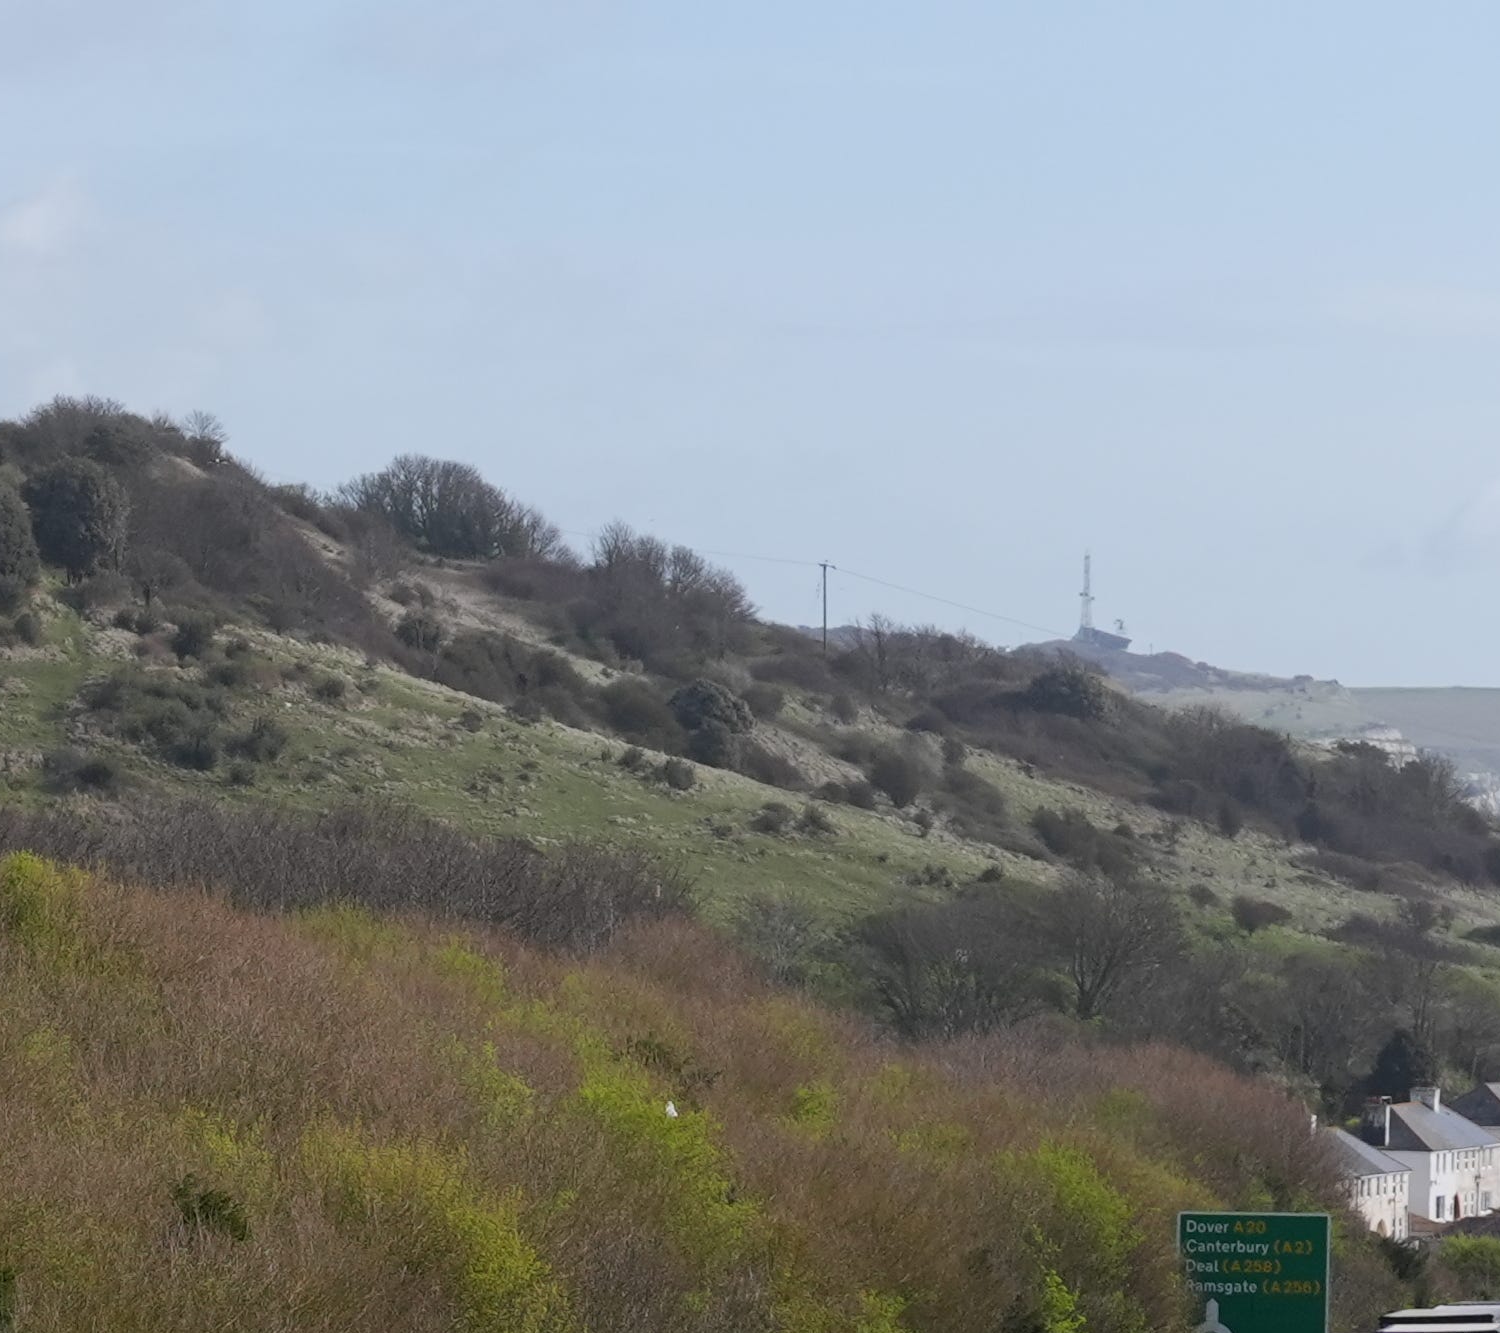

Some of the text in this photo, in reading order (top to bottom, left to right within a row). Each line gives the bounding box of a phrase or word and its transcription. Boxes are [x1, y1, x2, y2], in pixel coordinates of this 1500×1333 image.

[1186, 1219, 1266, 1234] Dover A20
[1186, 1239, 1270, 1256] Canterbury
[1186, 1259, 1219, 1272] Deal
[1186, 1279, 1257, 1295] Ramsgate
